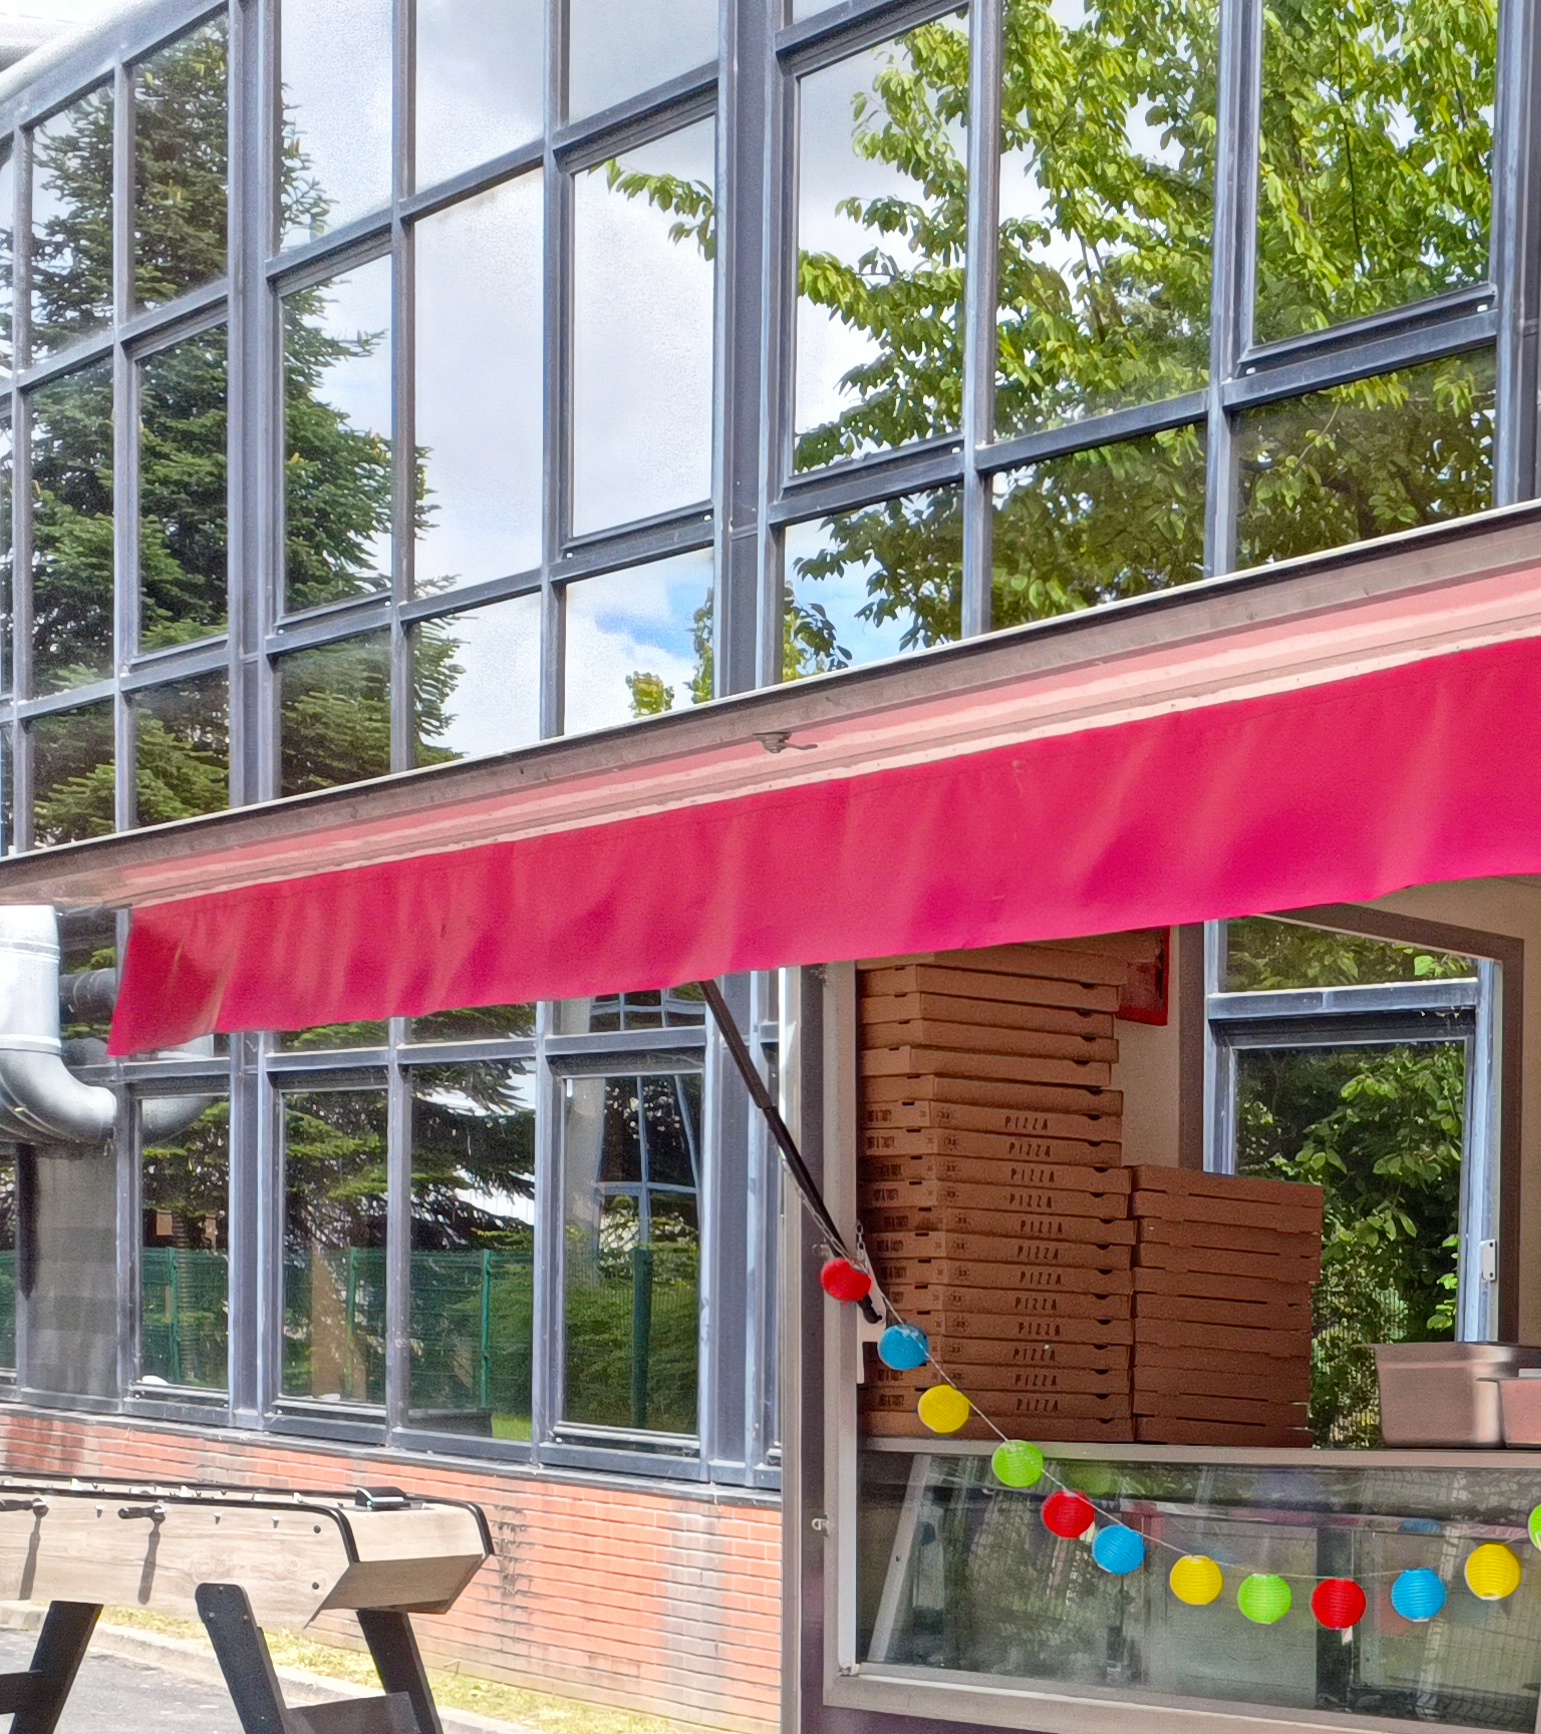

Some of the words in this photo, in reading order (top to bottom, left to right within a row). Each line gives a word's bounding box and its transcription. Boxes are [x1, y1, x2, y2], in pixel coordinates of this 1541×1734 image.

[1005, 1116, 1049, 1131] PIZZA
[1009, 1142, 1051, 1157] PIZZA
[1011, 1168, 1055, 1183] PIZZA
[1009, 1193, 1052, 1209] PIZZA
[1020, 1220, 1063, 1233] PIZZA
[1018, 1245, 1060, 1260] PIZZA
[1020, 1271, 1062, 1285] PIZZA
[1015, 1297, 1057, 1311] PIZZA
[1018, 1322, 1061, 1336] PIZZA
[1013, 1348, 1056, 1362] PIZZA
[1015, 1373, 1057, 1387] PIZZA
[1016, 1399, 1059, 1412] PIZZA
